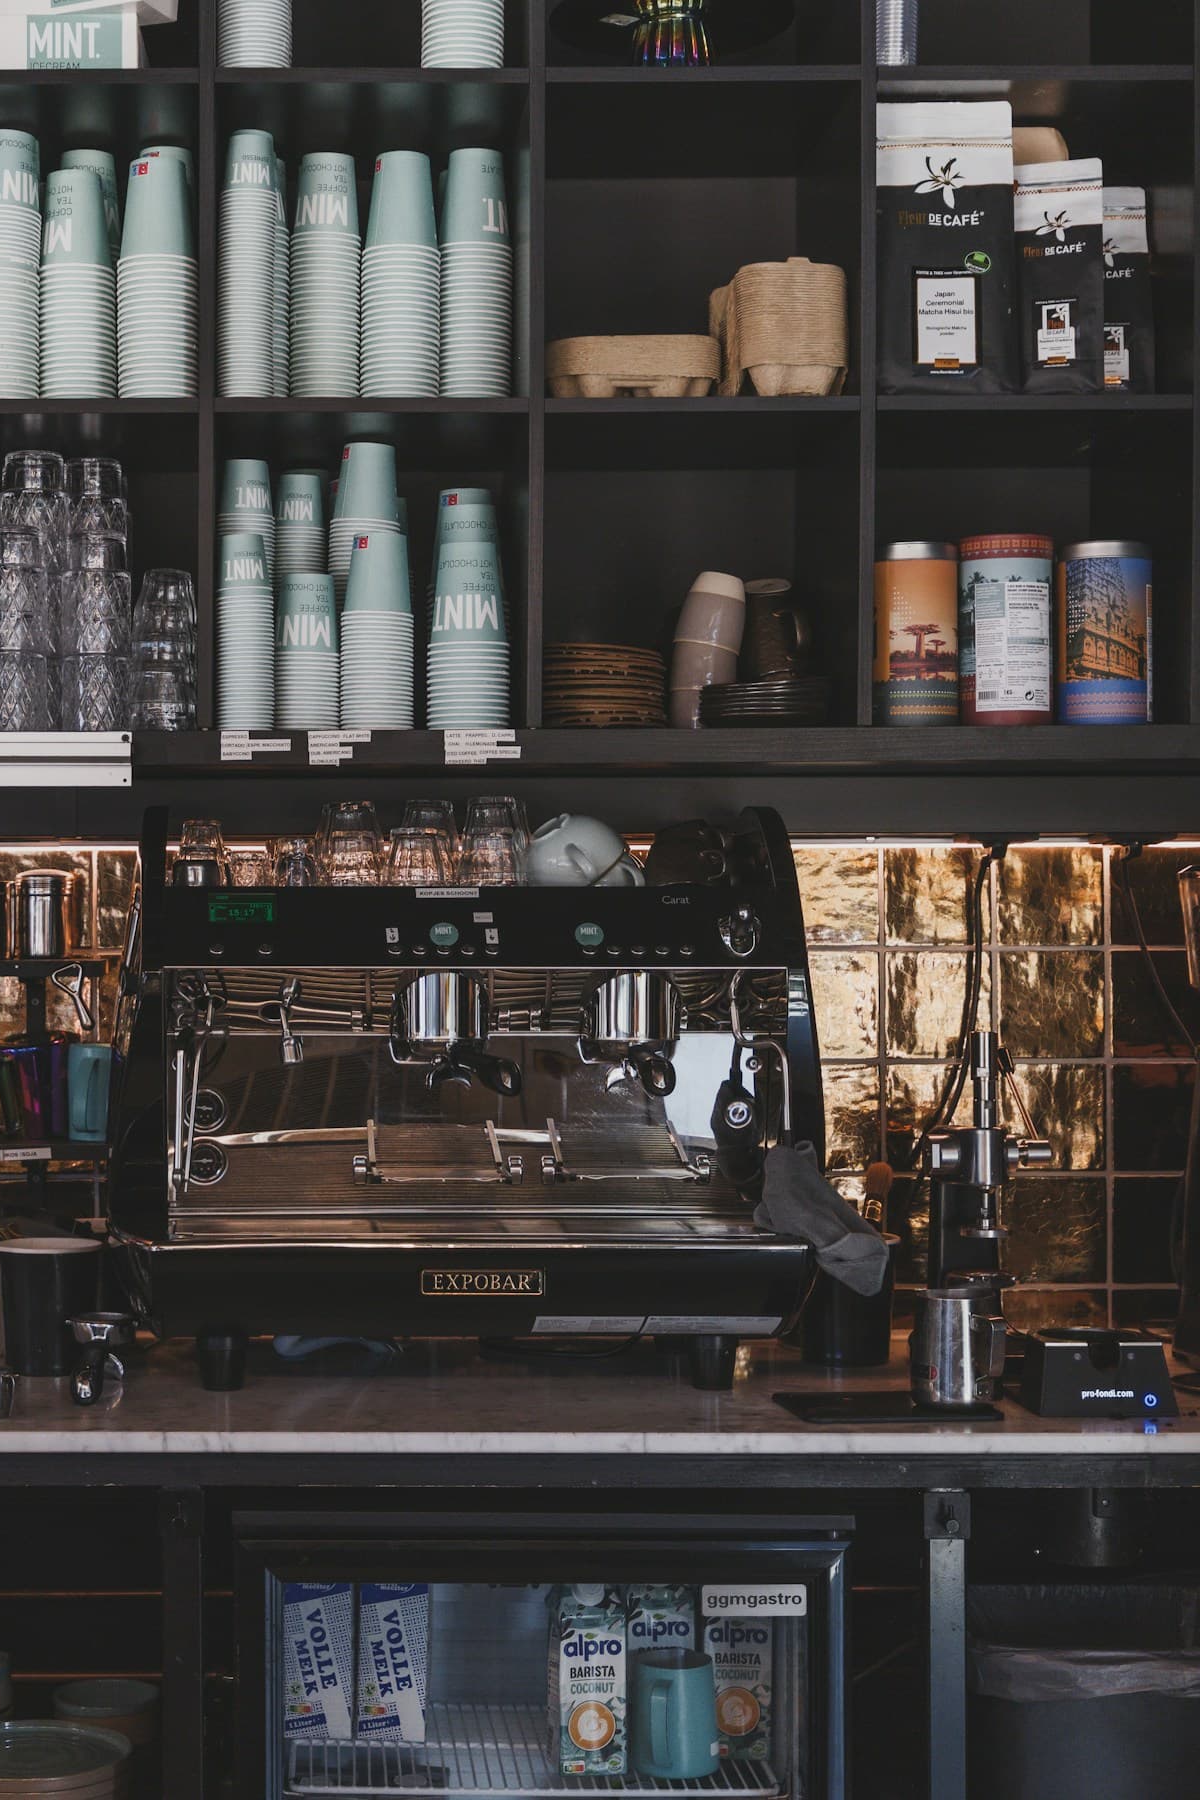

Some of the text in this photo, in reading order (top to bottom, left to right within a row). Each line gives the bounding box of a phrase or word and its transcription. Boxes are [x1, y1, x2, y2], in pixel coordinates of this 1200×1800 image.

[29, 22, 100, 59] MINT.
[333, 174, 347, 184] TEA
[317, 184, 348, 193] COFFEE
[56, 196, 73, 205] TEA
[928, 213, 942, 226] DE
[943, 210, 980, 227] CAFÉ
[1056, 241, 1083, 255] CAFÉ
[934, 291, 956, 299] Japan
[925, 299, 965, 307] Ceremonial
[918, 308, 943, 316] Matcha
[463, 582, 496, 592] COFFEE
[315, 595, 329, 603] TEA
[299, 604, 330, 613] COFFEE
[661, 895, 690, 905] Carat
[433, 1274, 531, 1290] EXPOBAR
[1081, 1389, 1134, 1400] pro-fondi.com
[706, 1593, 803, 1608] ggmgastro
[631, 1614, 690, 1642] alpro
[709, 1621, 769, 1648] alpro
[306, 1608, 338, 1689] VOLLE
[383, 1609, 413, 1691] VOLLE
[563, 1634, 622, 1661] alpro
[715, 1653, 761, 1665] BARISTA
[295, 1639, 319, 1696] MELK
[371, 1640, 394, 1697] MELK
[570, 1665, 616, 1679] BARISTA
[715, 1669, 760, 1681] COCONUT
[570, 1682, 615, 1694] COCONUT
[294, 1718, 312, 1727] Liter
[367, 1719, 386, 1728] Liter
